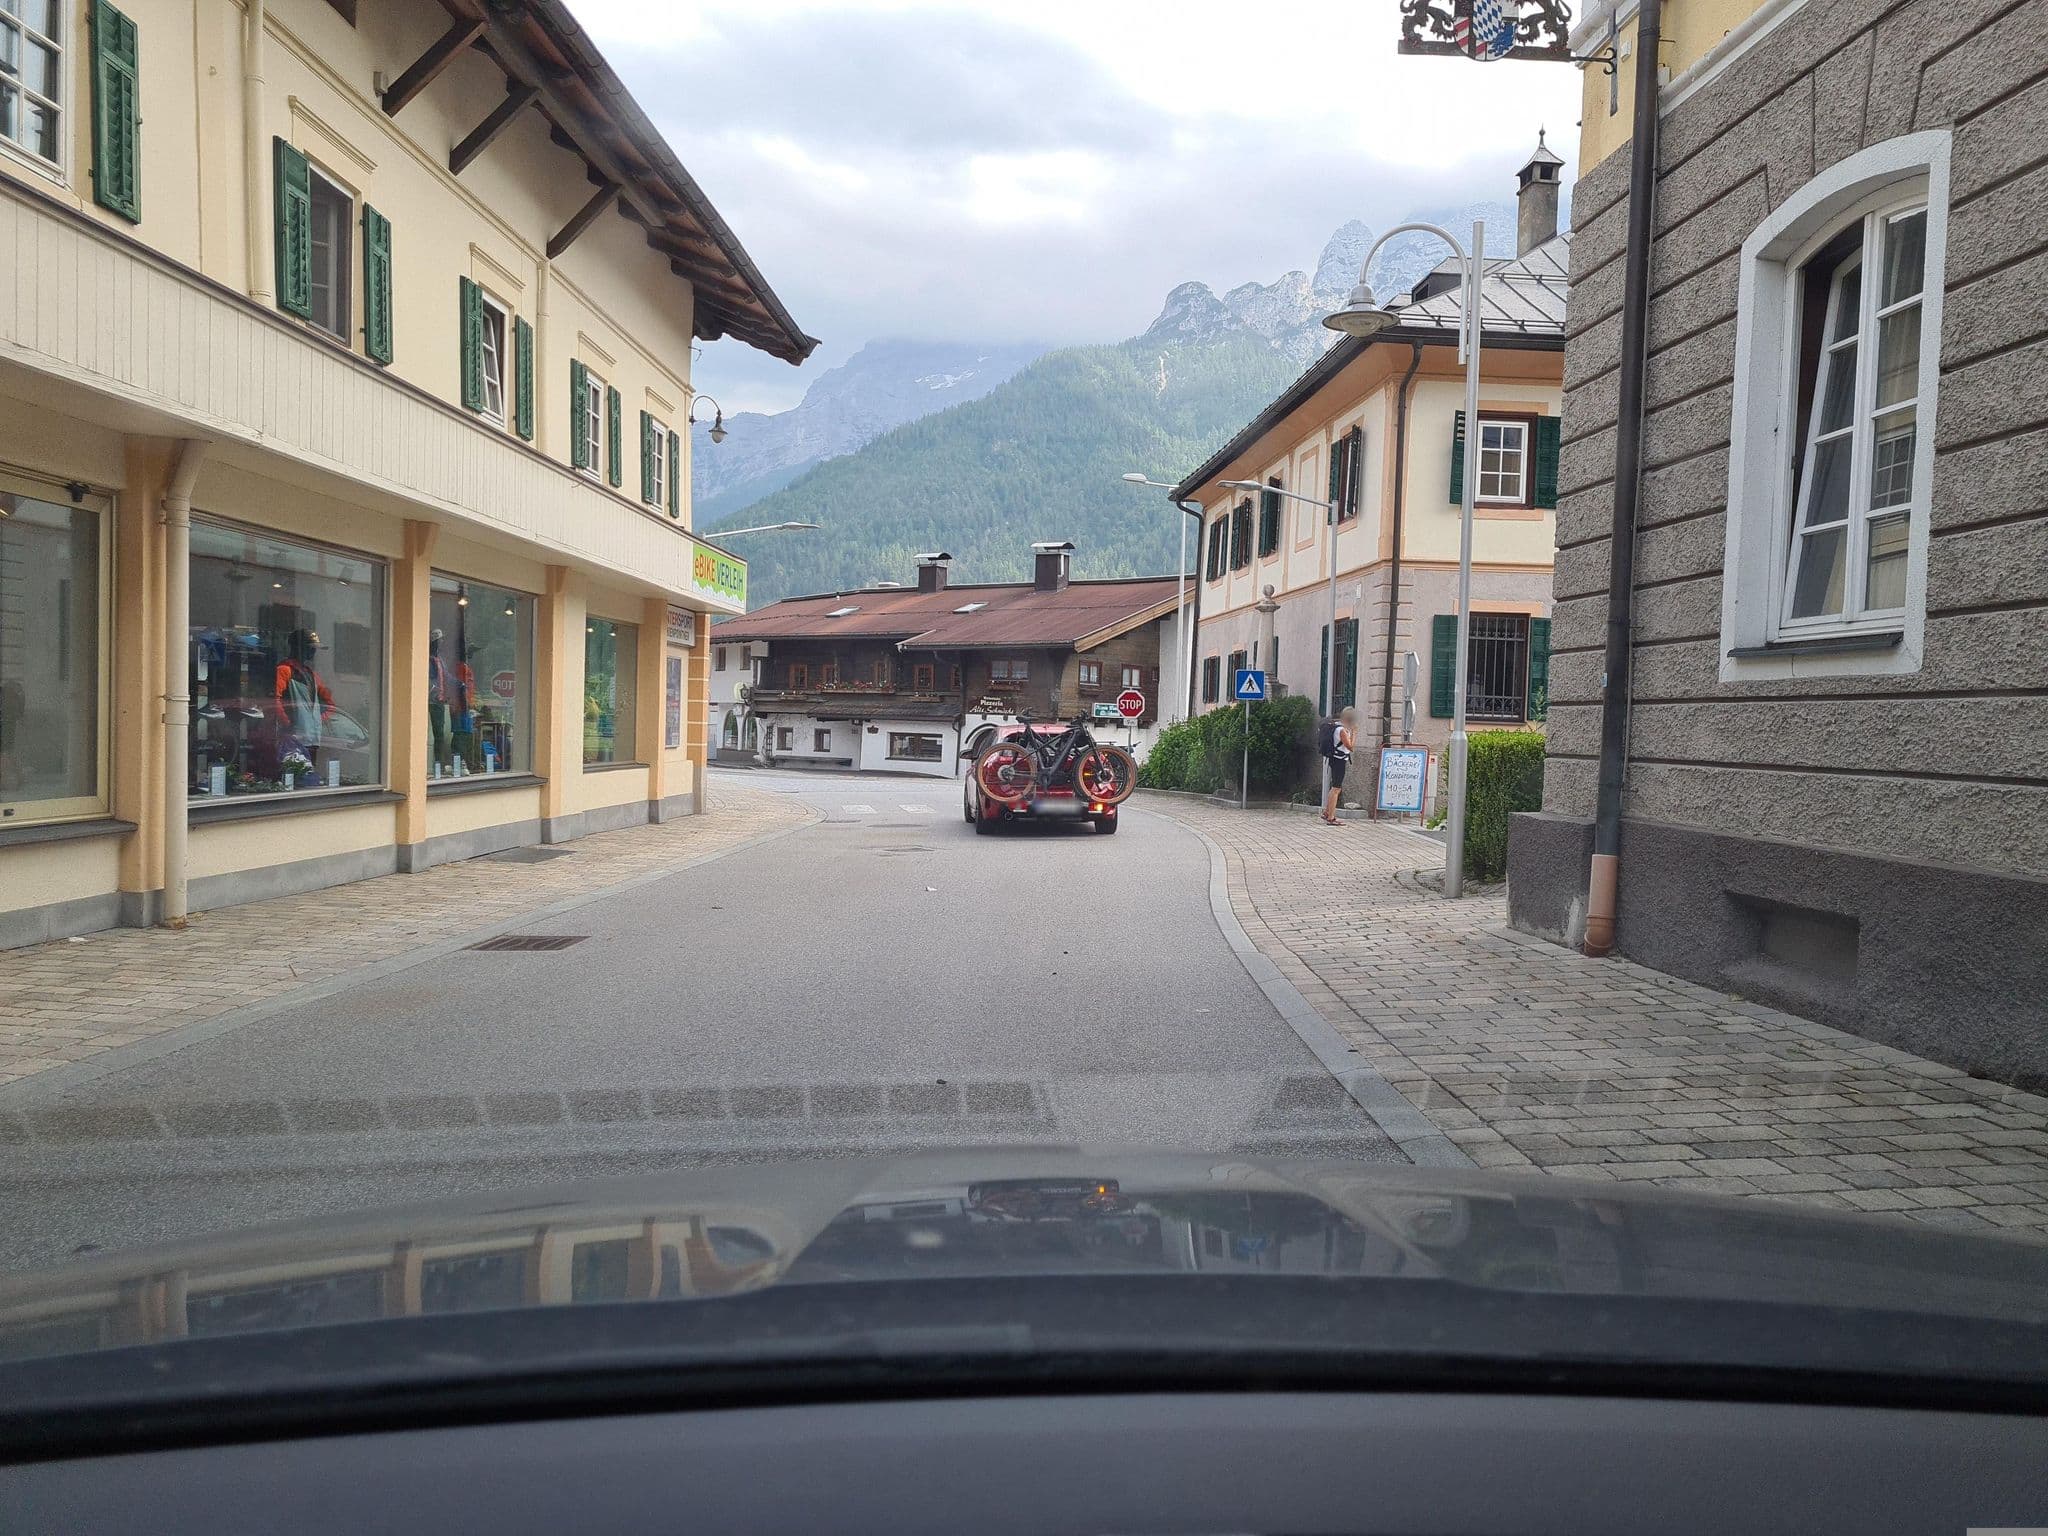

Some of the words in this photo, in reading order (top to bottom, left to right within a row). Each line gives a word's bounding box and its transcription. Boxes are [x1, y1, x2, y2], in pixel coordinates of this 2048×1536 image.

[695, 554, 715, 582] eBIKE
[717, 560, 743, 592] VERLEIH
[980, 699, 1004, 707] Pizzeria
[1120, 699, 1142, 710] STOP
